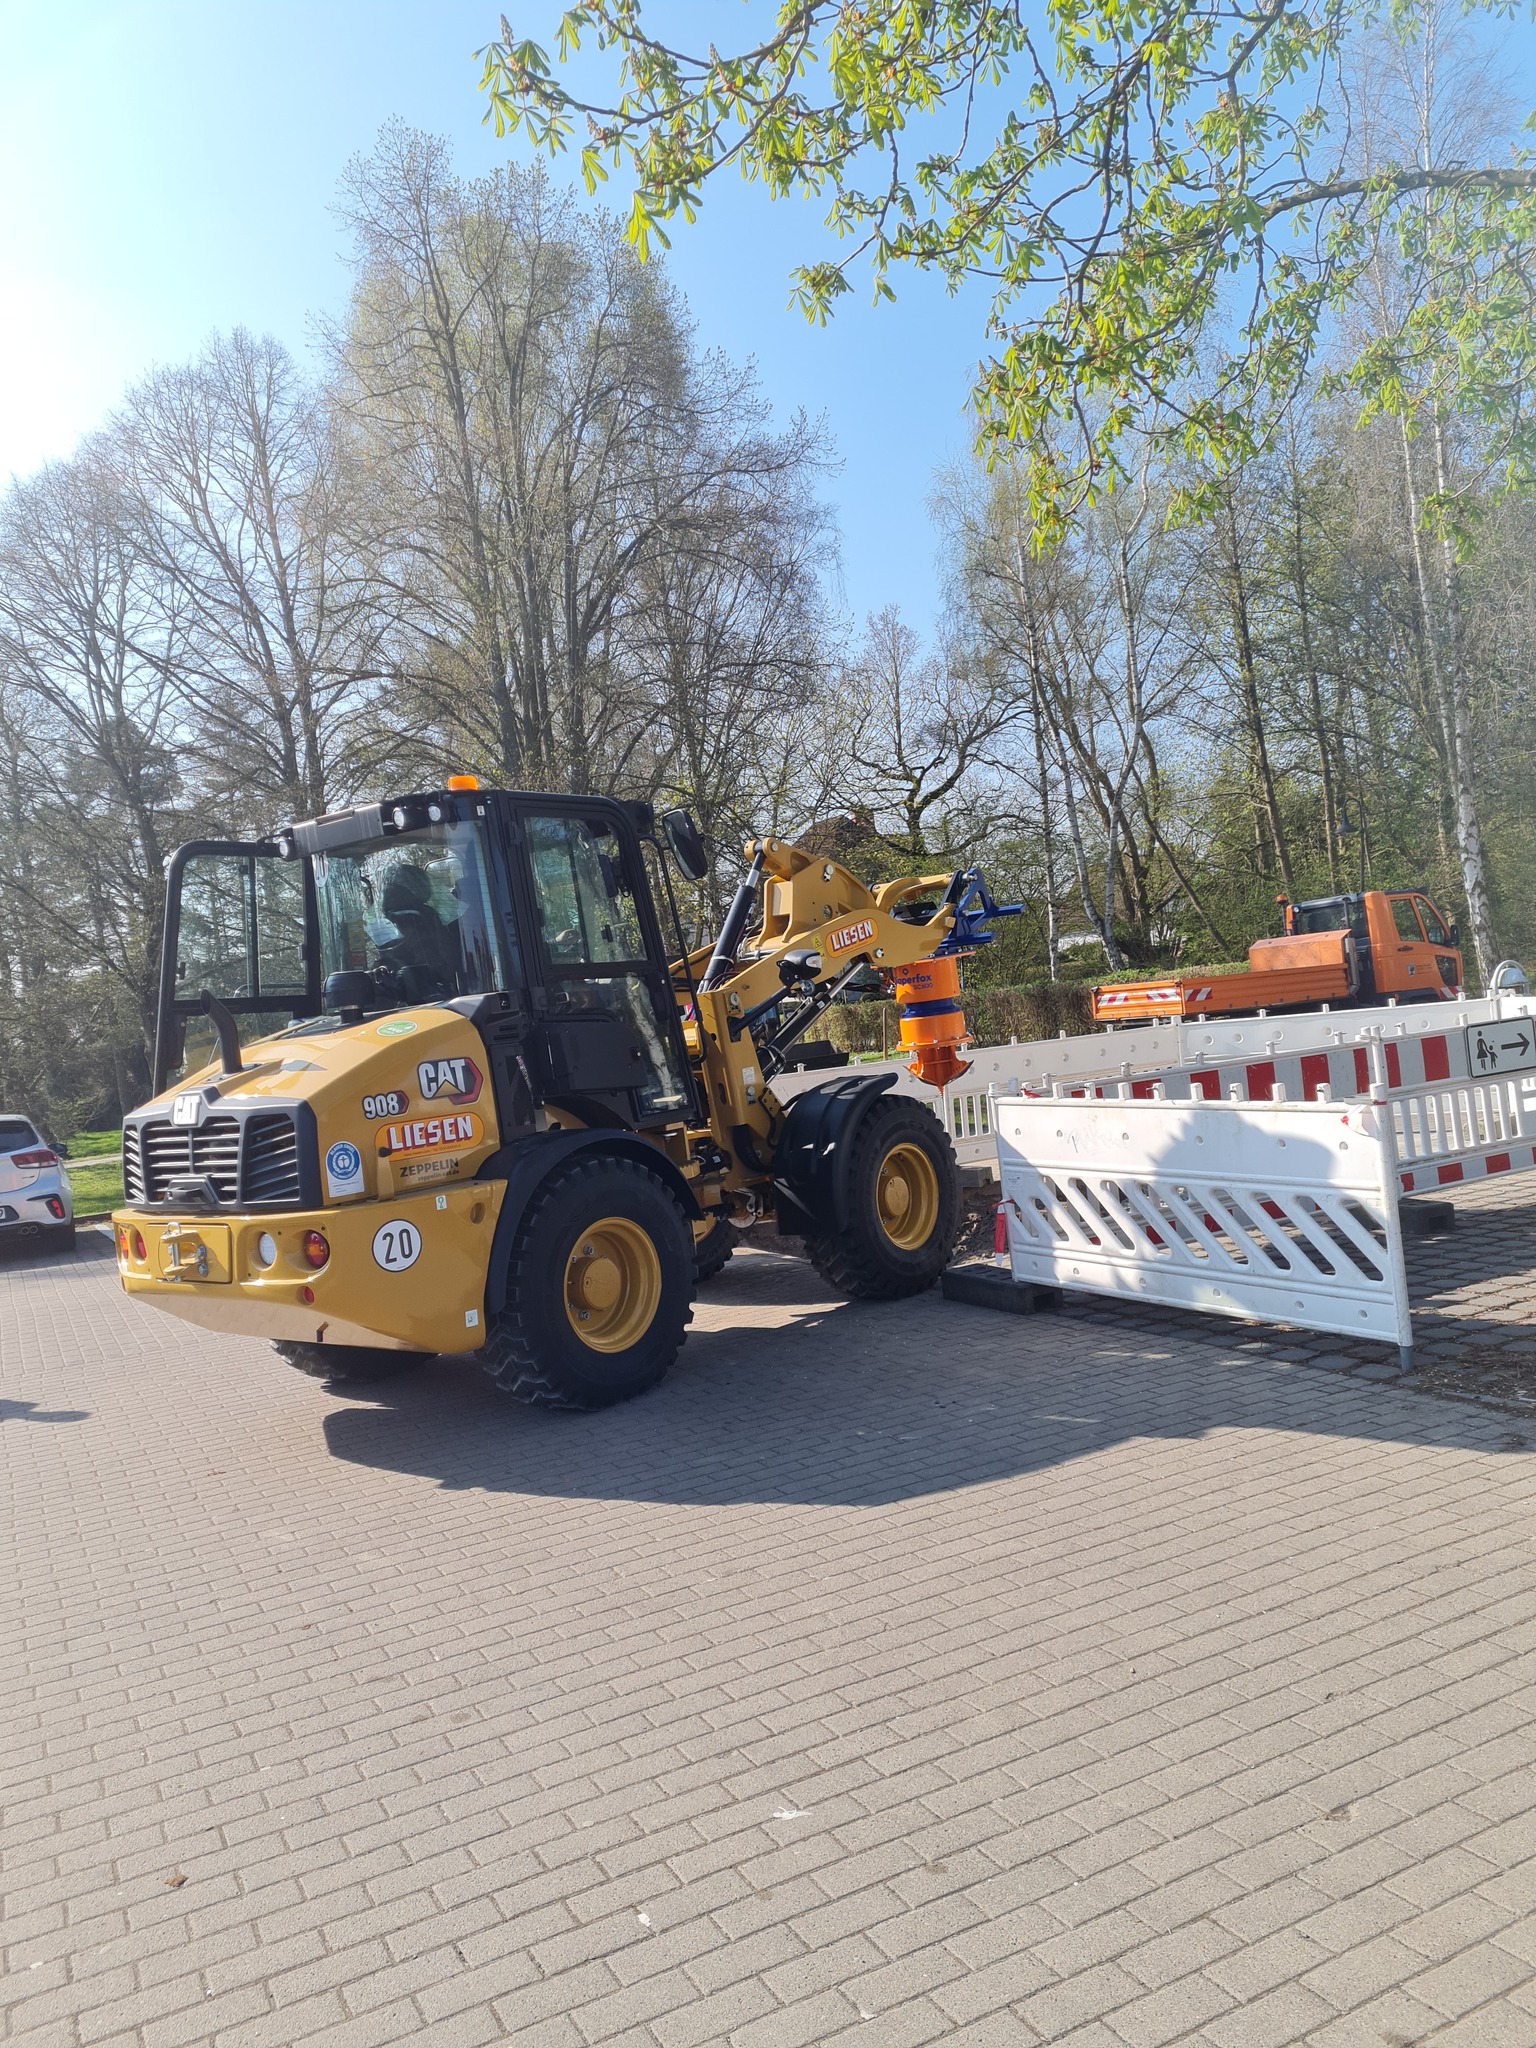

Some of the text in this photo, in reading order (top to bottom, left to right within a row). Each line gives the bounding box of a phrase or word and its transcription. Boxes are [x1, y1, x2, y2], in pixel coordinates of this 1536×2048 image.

[831, 921, 873, 951] LIESEN
[418, 1058, 466, 1098] CAT
[363, 1093, 399, 1119] 908
[388, 1115, 473, 1151] LIESEN
[400, 1158, 459, 1178] ZEPPELIN
[382, 1228, 413, 1264] 20
